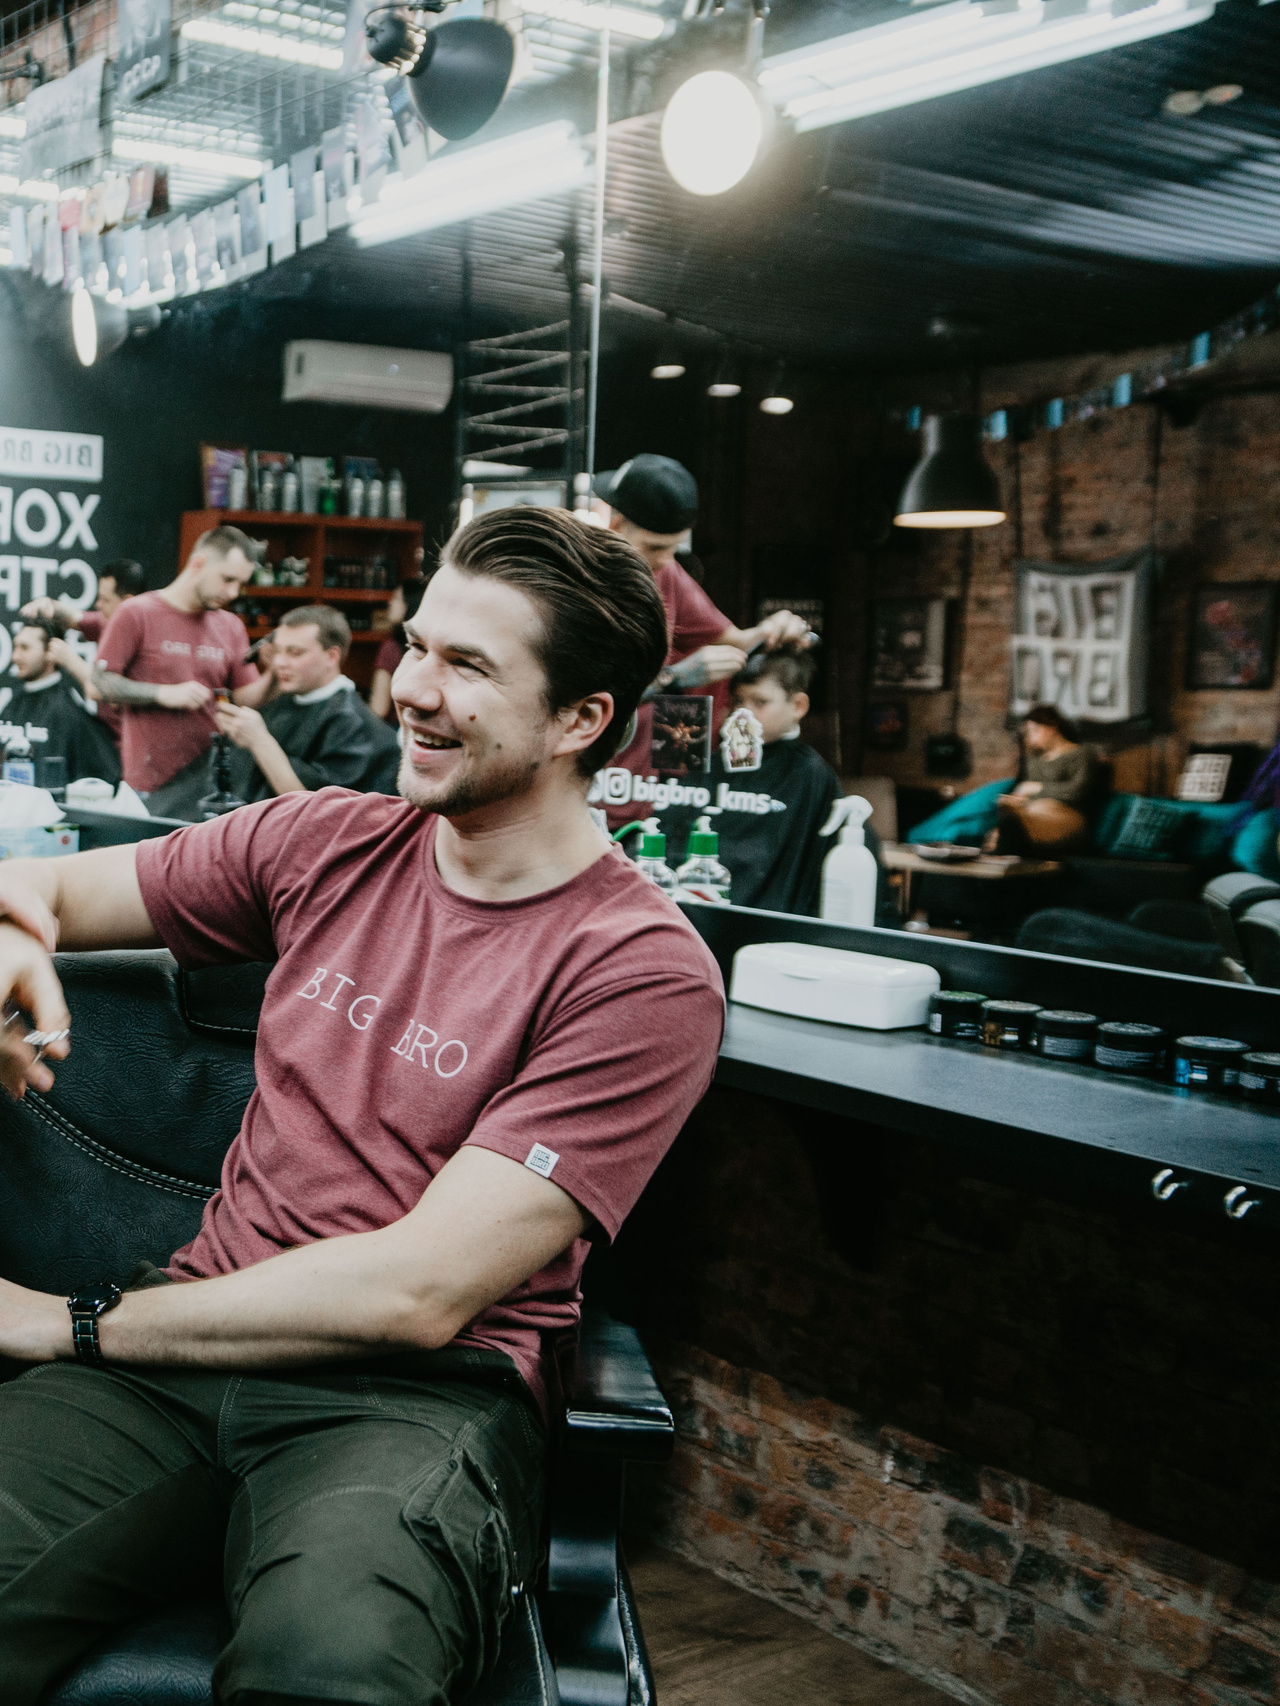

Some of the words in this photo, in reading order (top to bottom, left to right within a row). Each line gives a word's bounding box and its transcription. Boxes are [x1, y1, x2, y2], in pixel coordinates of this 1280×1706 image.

[632, 775, 772, 815] bigbro_kms
[296, 967, 382, 1031] BIG
[390, 1019, 468, 1079] BRO
[530, 1157, 551, 1171] BRO
